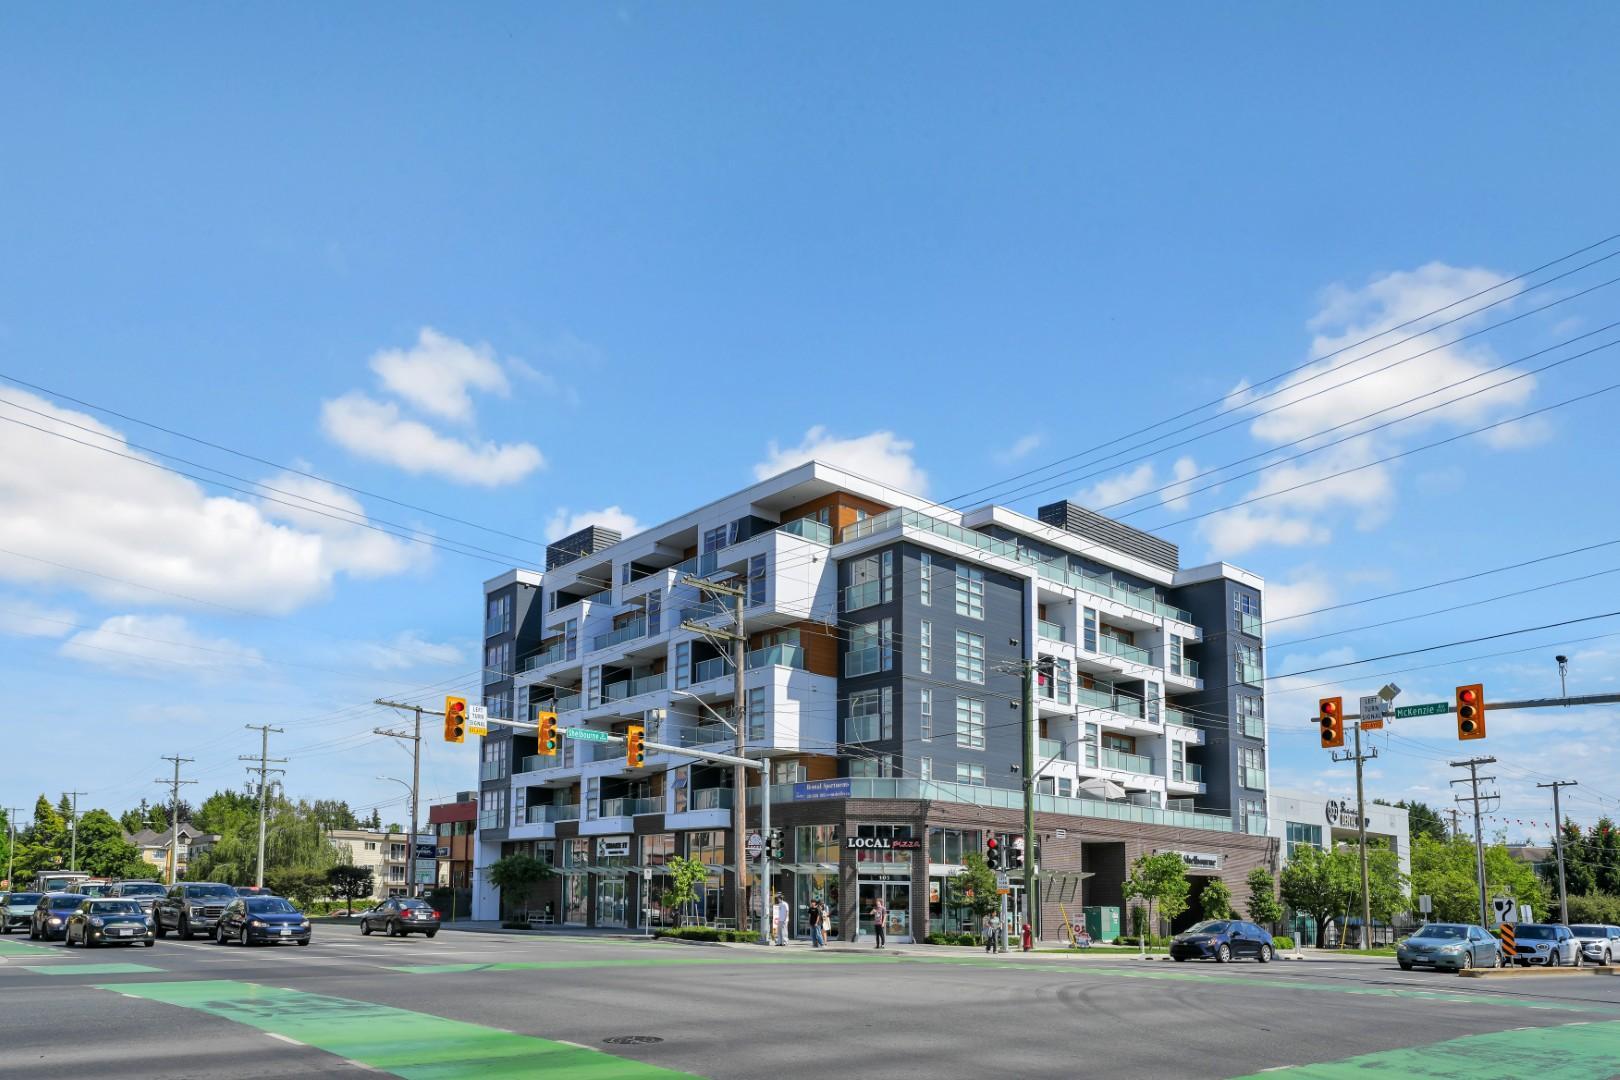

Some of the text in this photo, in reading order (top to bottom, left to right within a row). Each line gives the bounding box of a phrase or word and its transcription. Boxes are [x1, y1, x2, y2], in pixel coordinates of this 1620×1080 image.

[1397, 706, 1434, 717] McKenzie
[568, 729, 599, 740] Shelbourne
[847, 838, 891, 848] LOCAL
